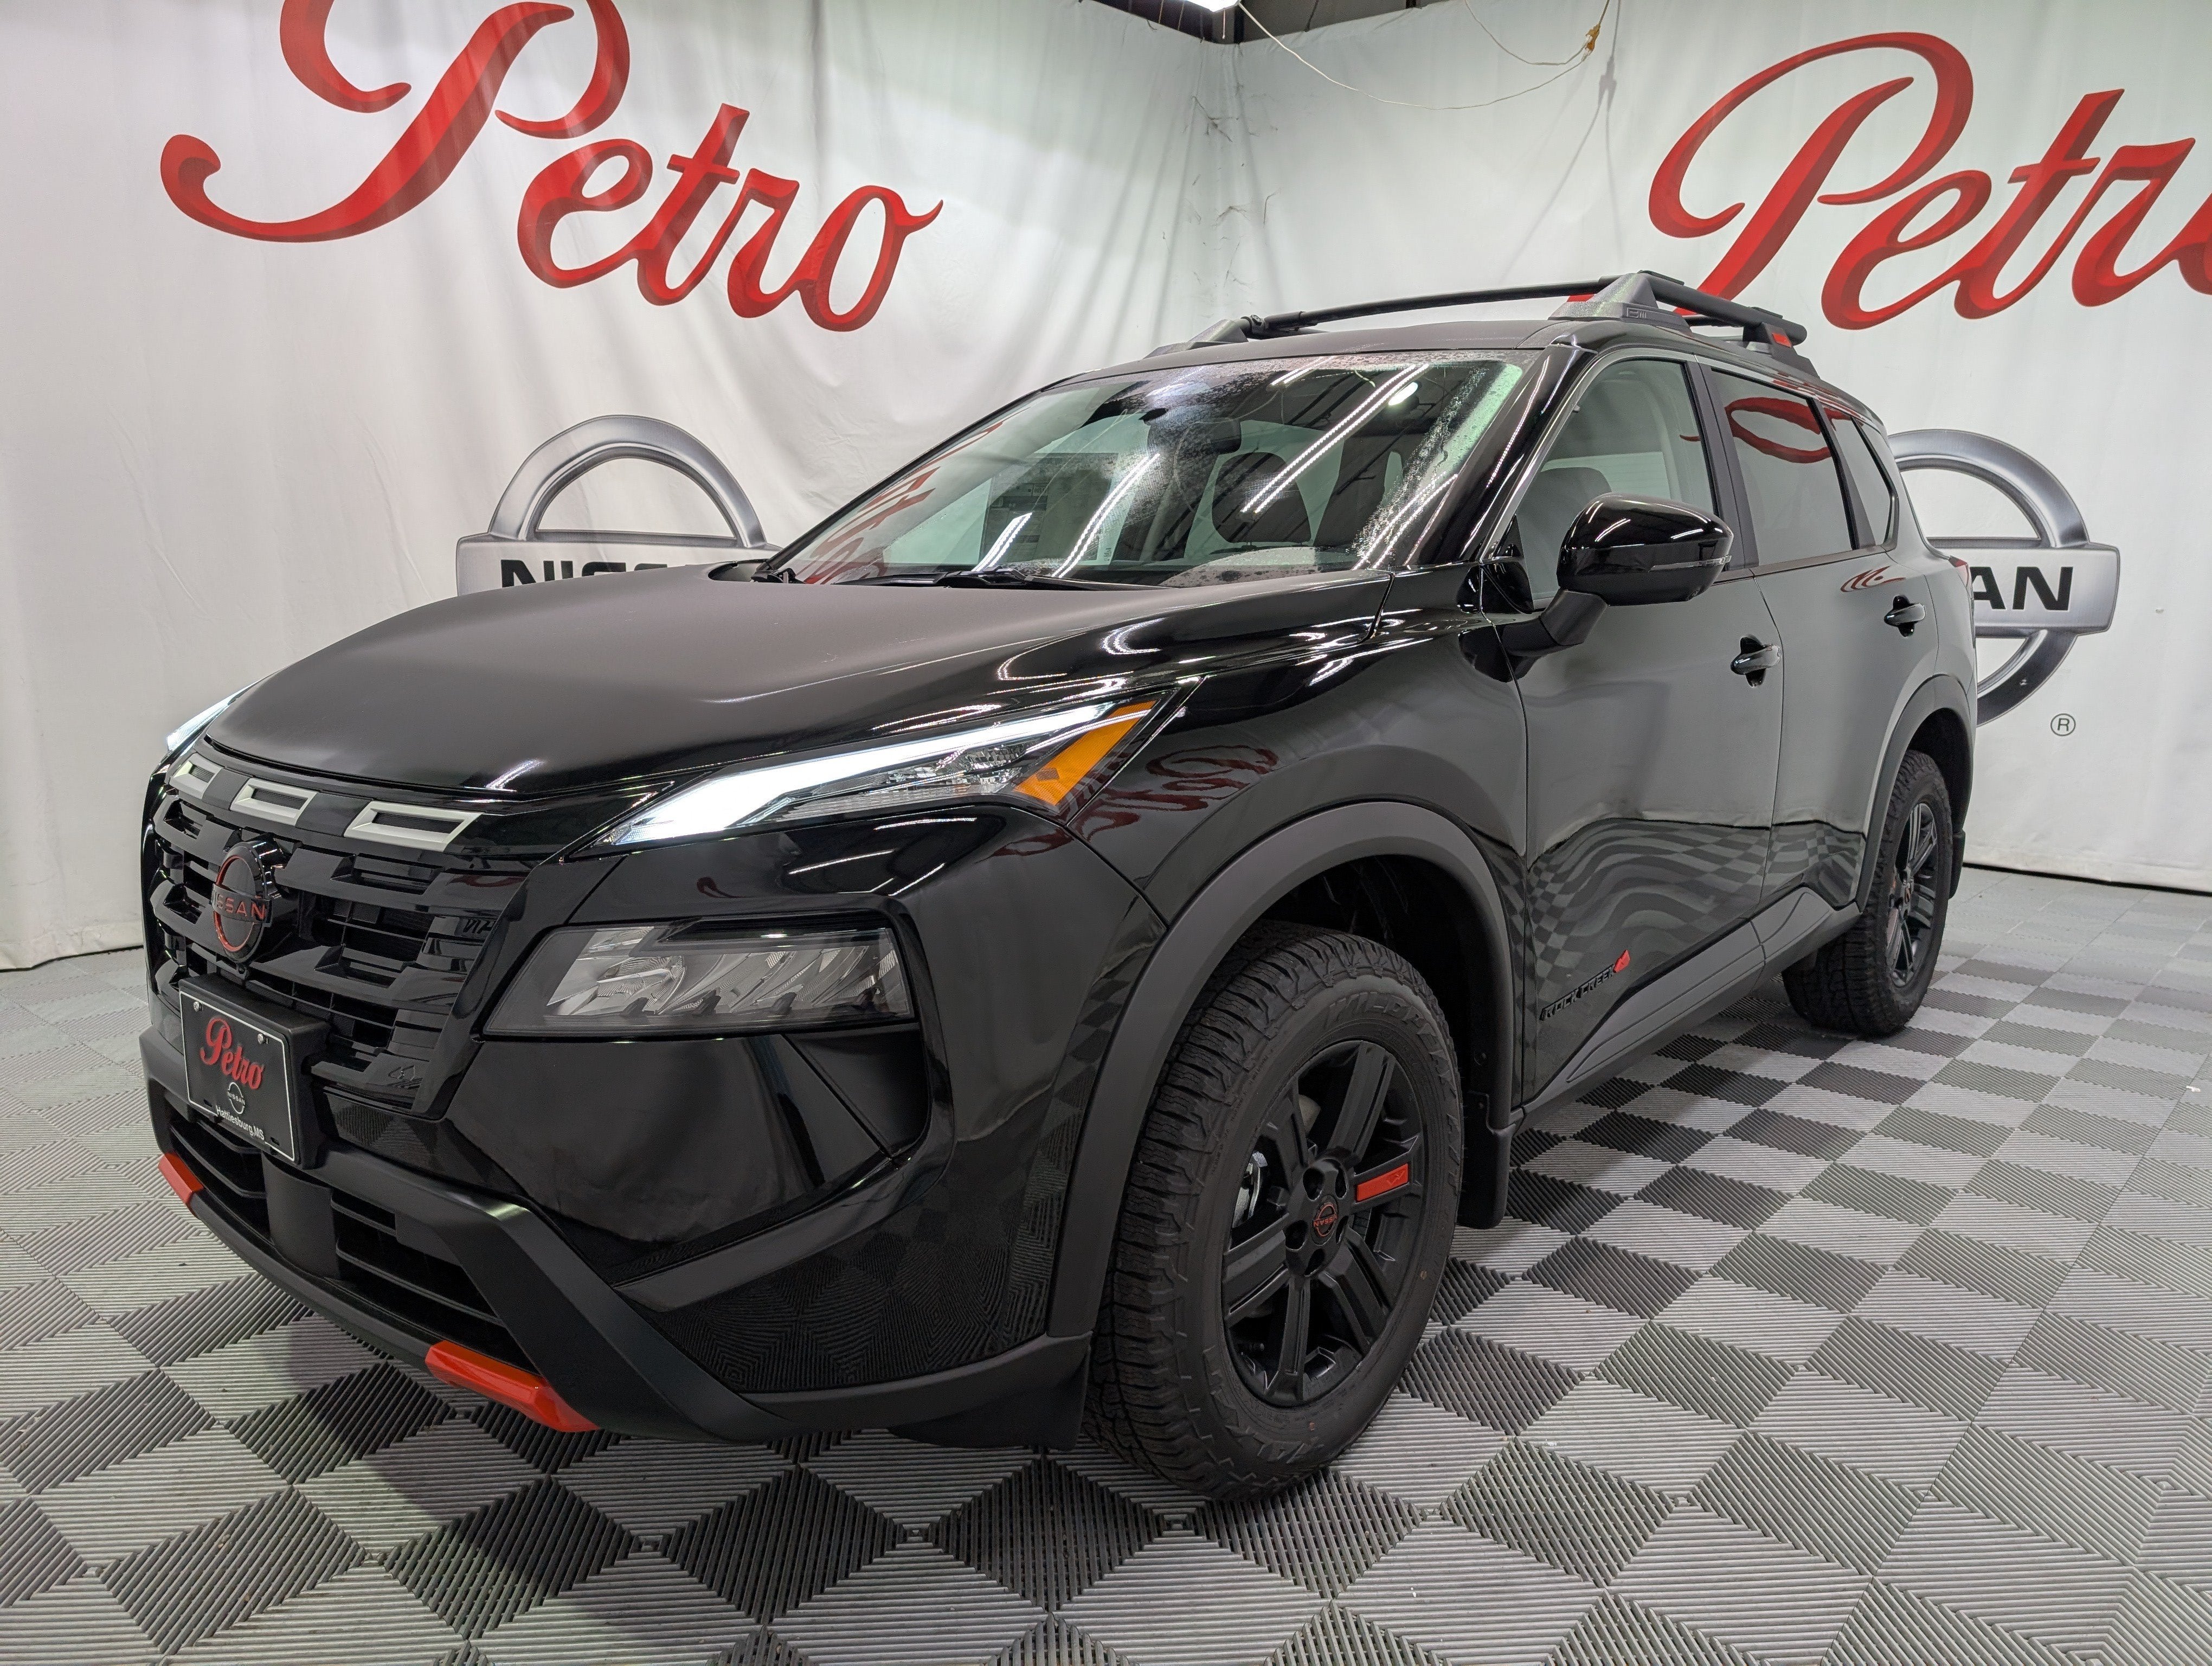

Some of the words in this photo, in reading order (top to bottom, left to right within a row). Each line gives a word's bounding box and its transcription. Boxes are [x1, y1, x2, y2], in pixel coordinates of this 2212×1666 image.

[160, 0, 943, 332] Petro
[1969, 566, 2074, 611] AN
[200, 1017, 265, 1090] Petro
[227, 1091, 246, 1106] NISSAN
